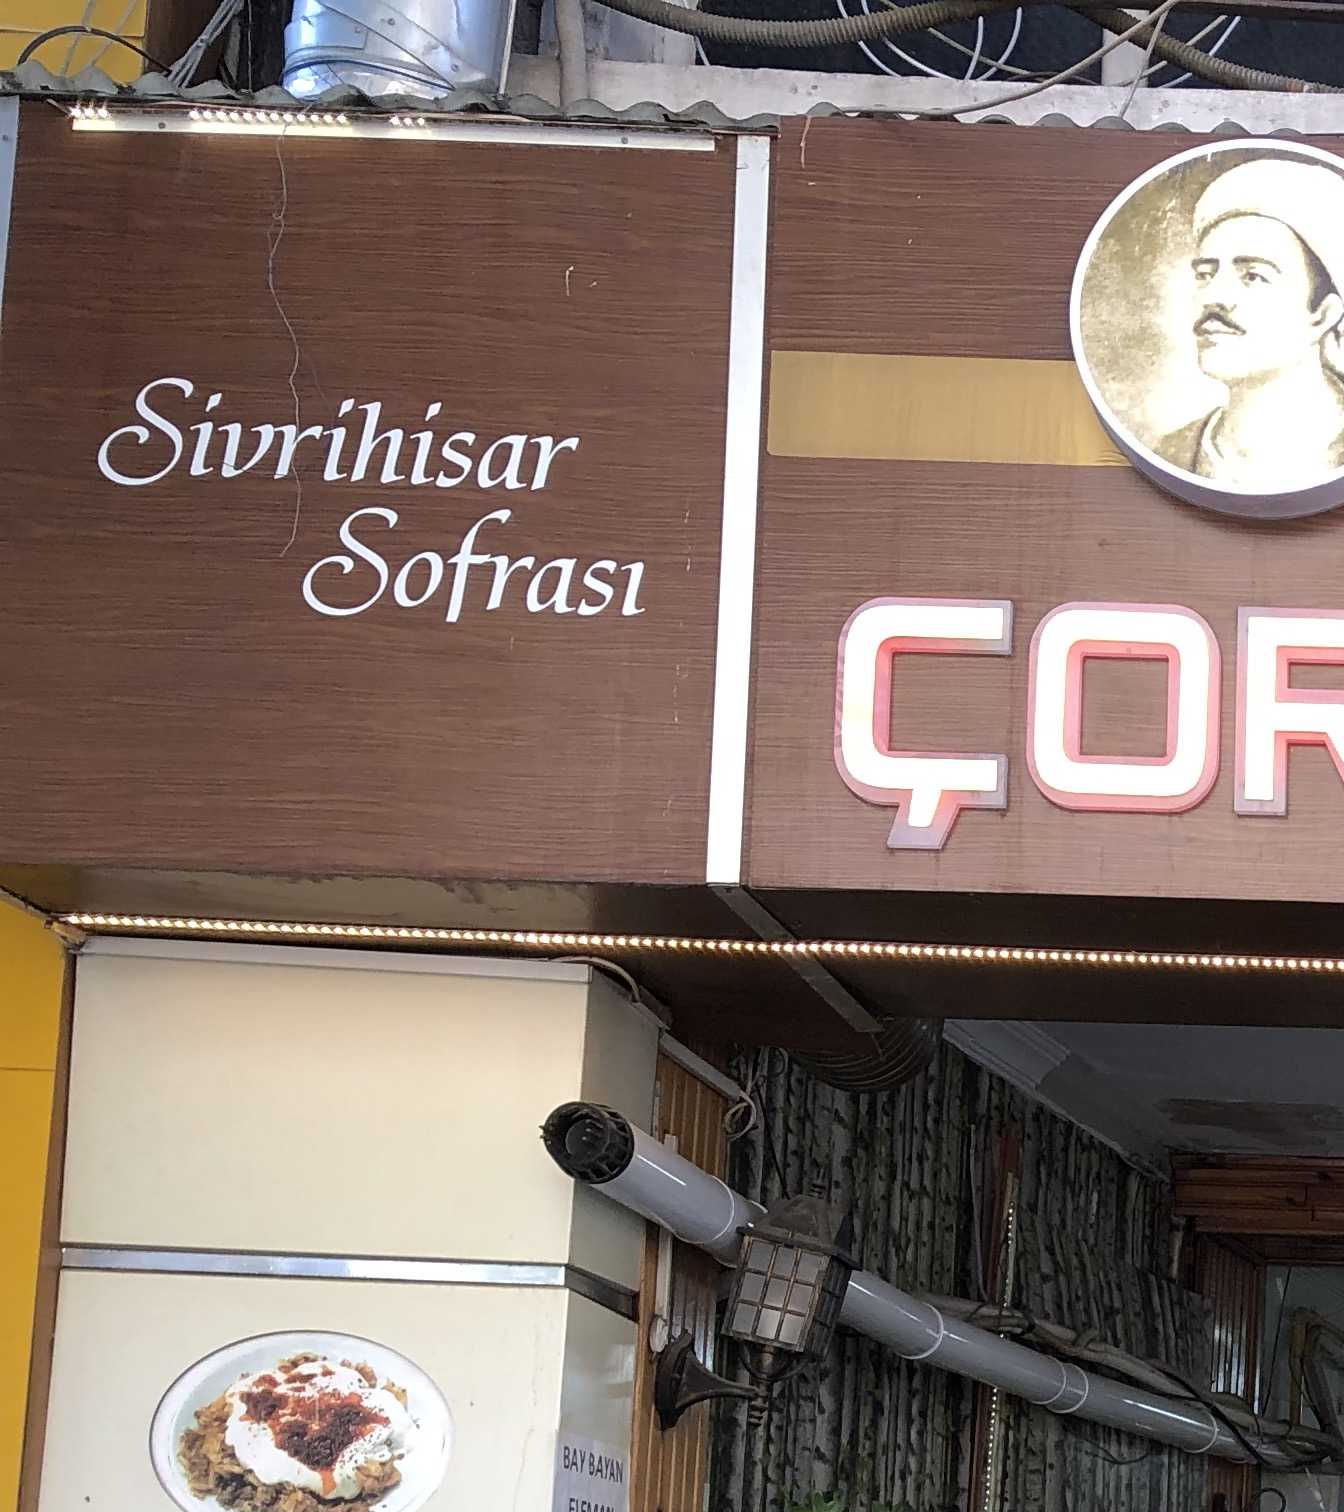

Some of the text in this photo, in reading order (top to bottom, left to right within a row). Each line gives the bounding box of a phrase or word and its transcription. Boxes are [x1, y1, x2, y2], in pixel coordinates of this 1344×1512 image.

[96, 377, 579, 492] Sivrihisar
[301, 507, 646, 623] Sofrası
[563, 1445, 624, 1484] BAY BAYAN
